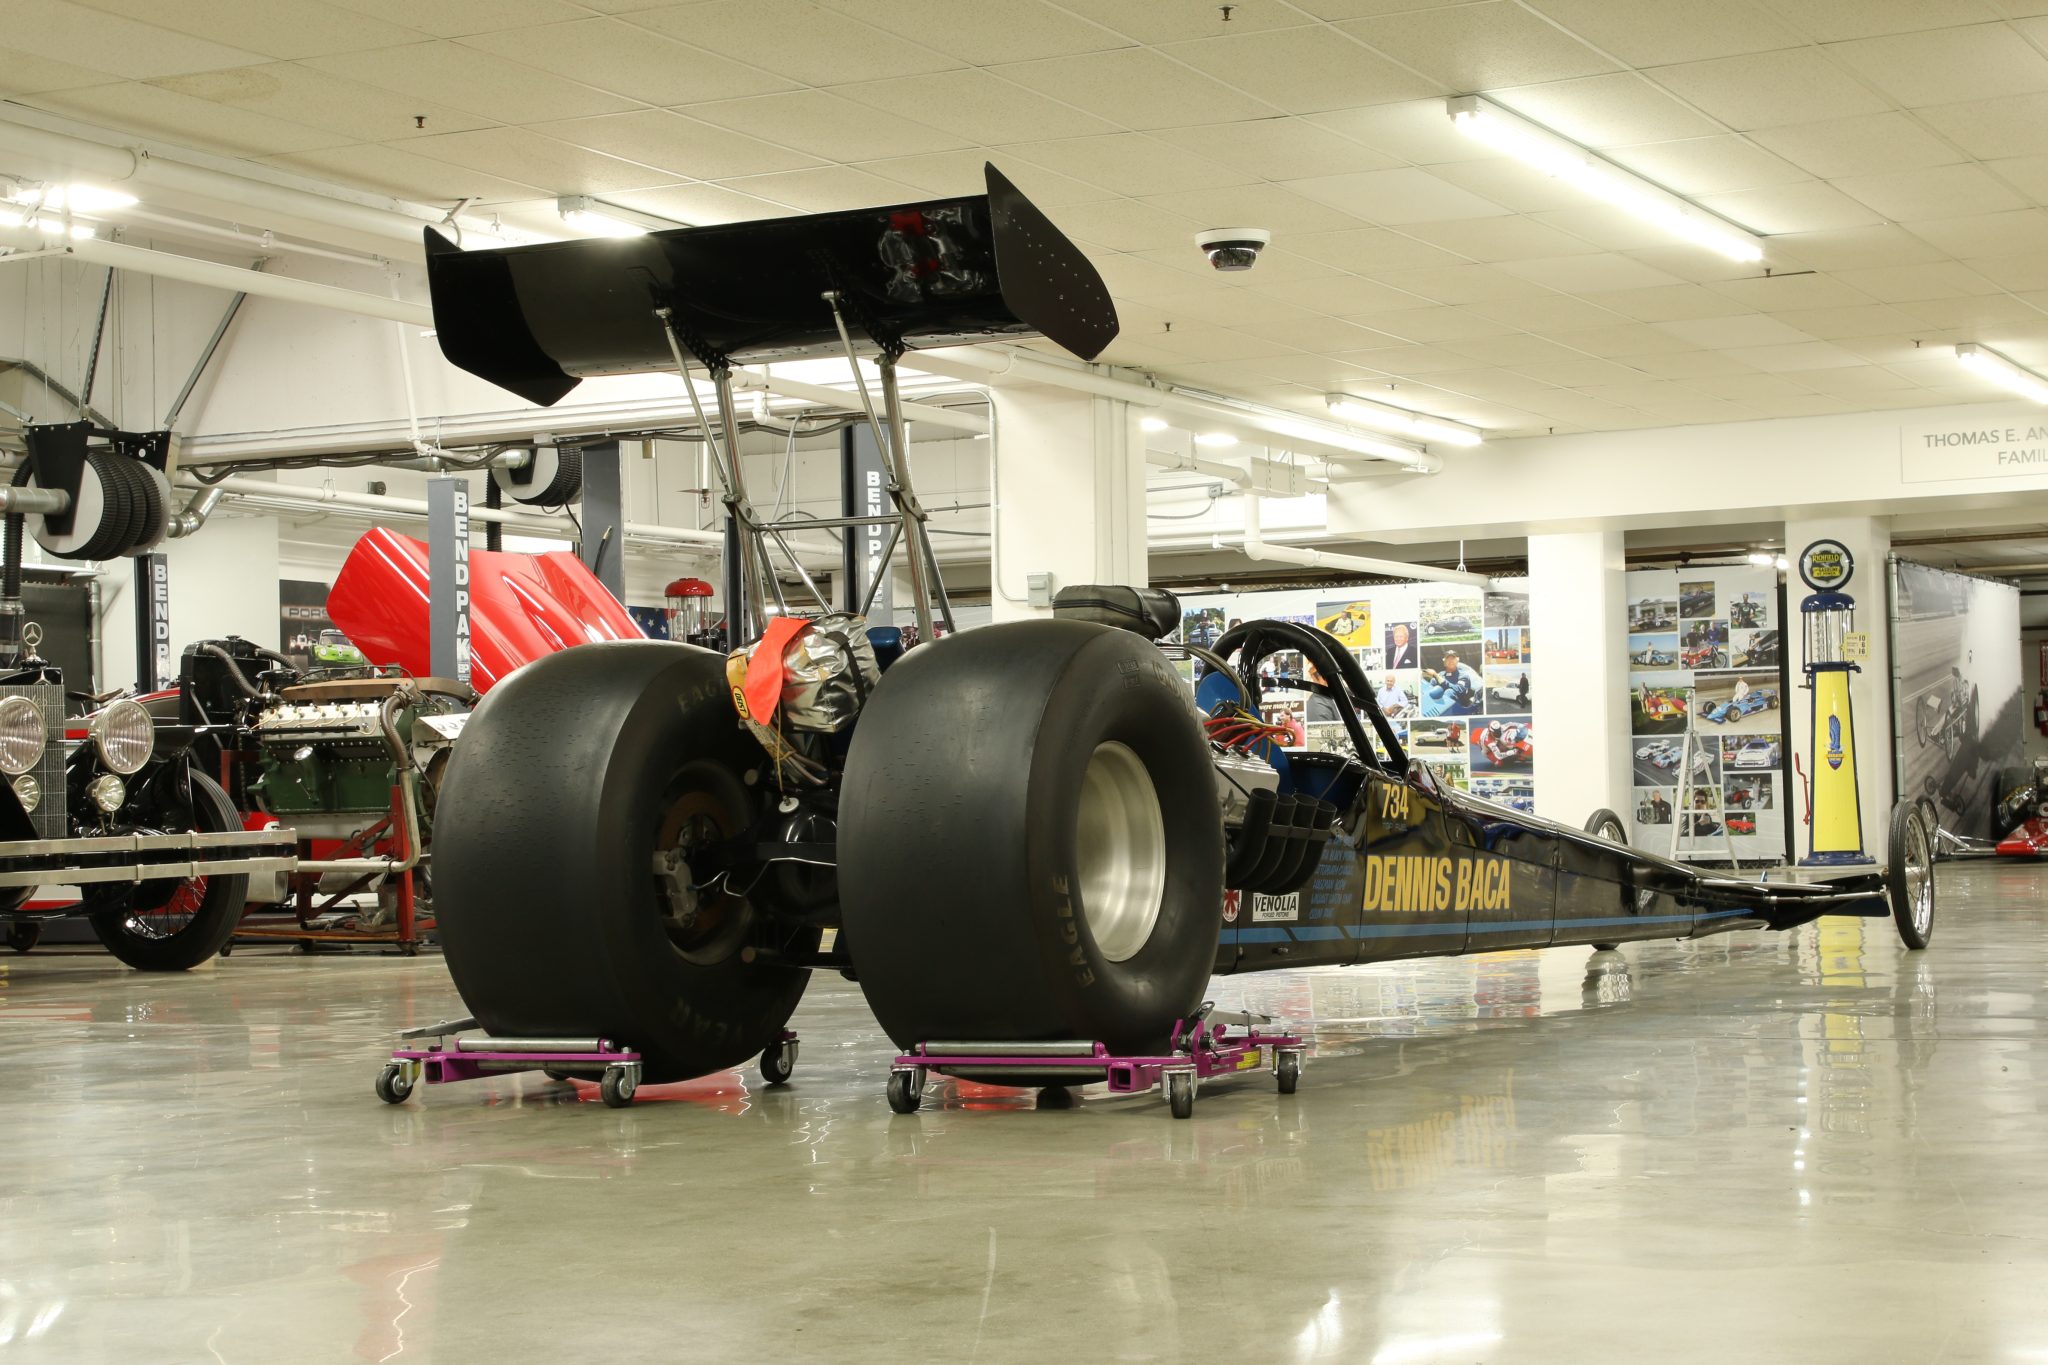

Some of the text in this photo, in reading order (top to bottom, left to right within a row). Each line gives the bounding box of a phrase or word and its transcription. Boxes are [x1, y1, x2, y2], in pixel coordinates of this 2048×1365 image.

[1924, 429, 2000, 448] THOMAS
[2005, 428, 2020, 442] E.
[454, 491, 470, 660] BENDPAK
[734, 692, 748, 713] DEIST
[1272, 702, 1290, 710] made
[1290, 702, 1300, 710] for
[1382, 784, 1409, 820] 734
[1363, 855, 1510, 912] DENNIS BACA
[1255, 896, 1296, 911] VENOLIA
[1051, 874, 1095, 987] EAGLE
